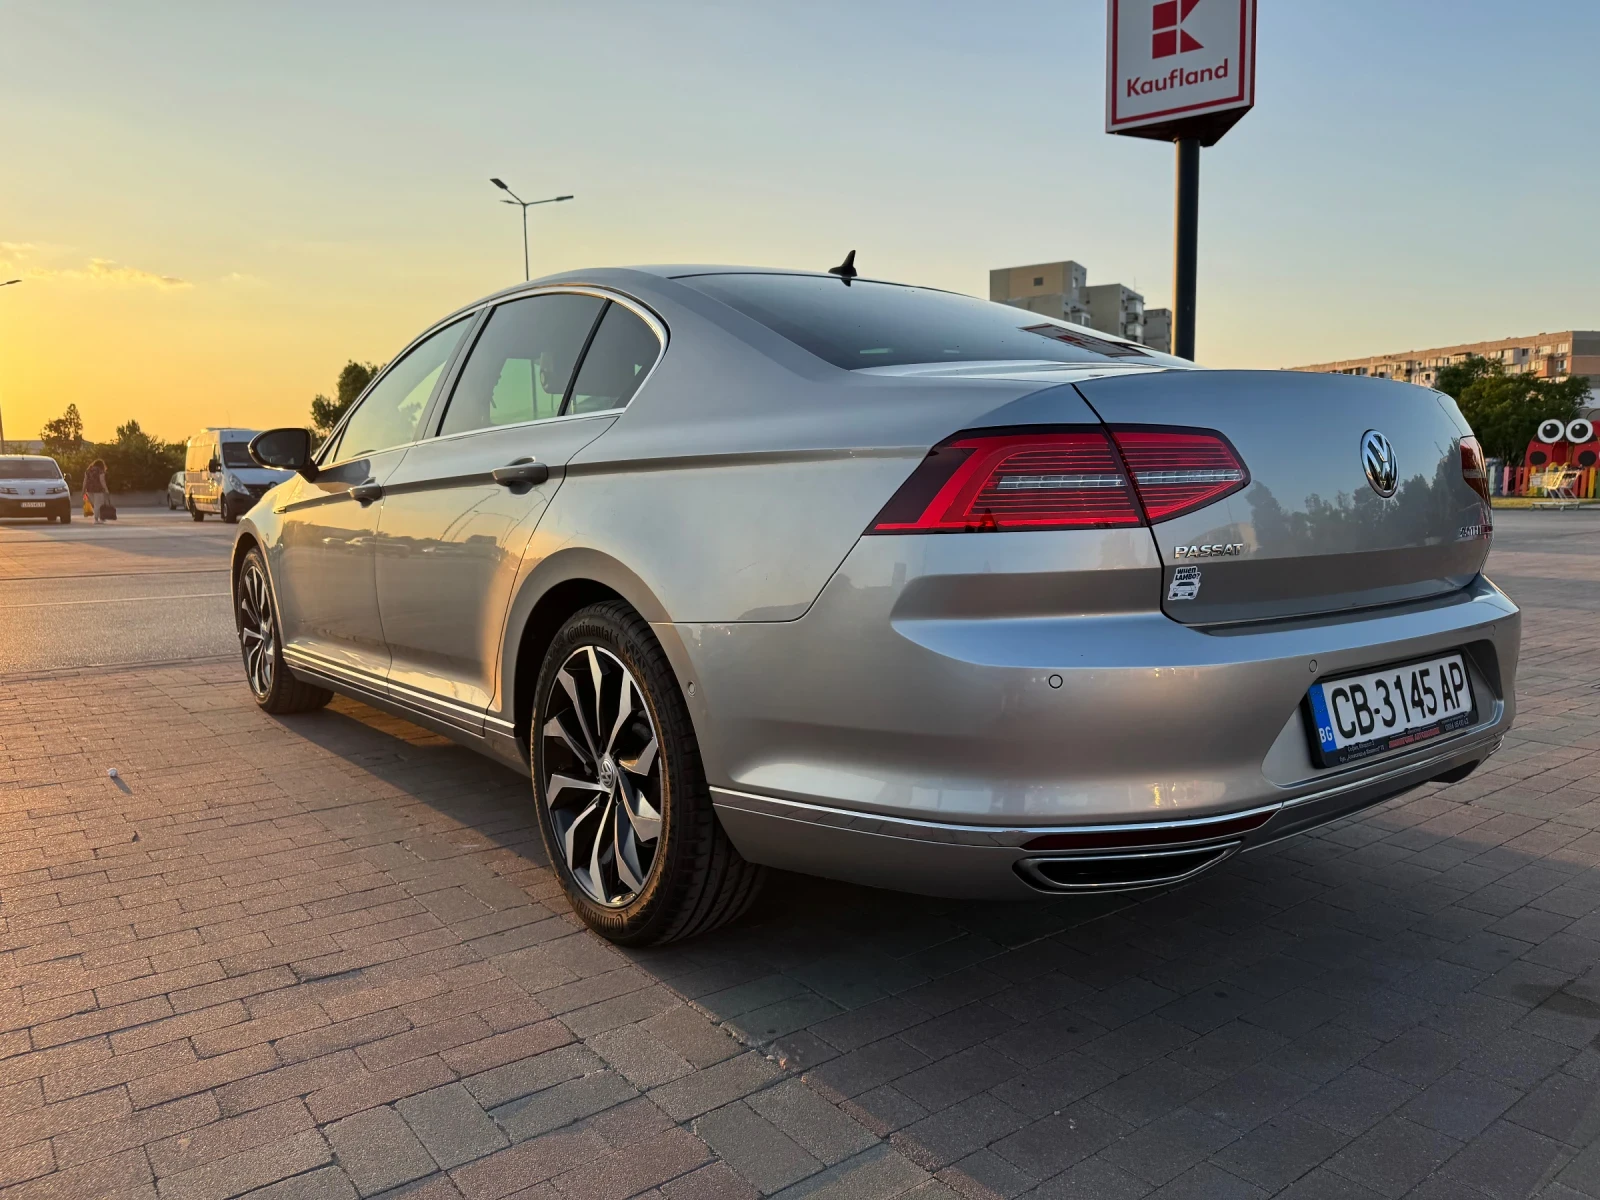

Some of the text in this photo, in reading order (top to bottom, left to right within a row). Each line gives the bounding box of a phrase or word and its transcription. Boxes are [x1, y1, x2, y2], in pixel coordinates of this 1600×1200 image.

[1127, 58, 1228, 97] Kaufland
[1174, 543, 1243, 559] PASSAT
[567, 622, 613, 644] Continental
[1319, 726, 1333, 744] BG
